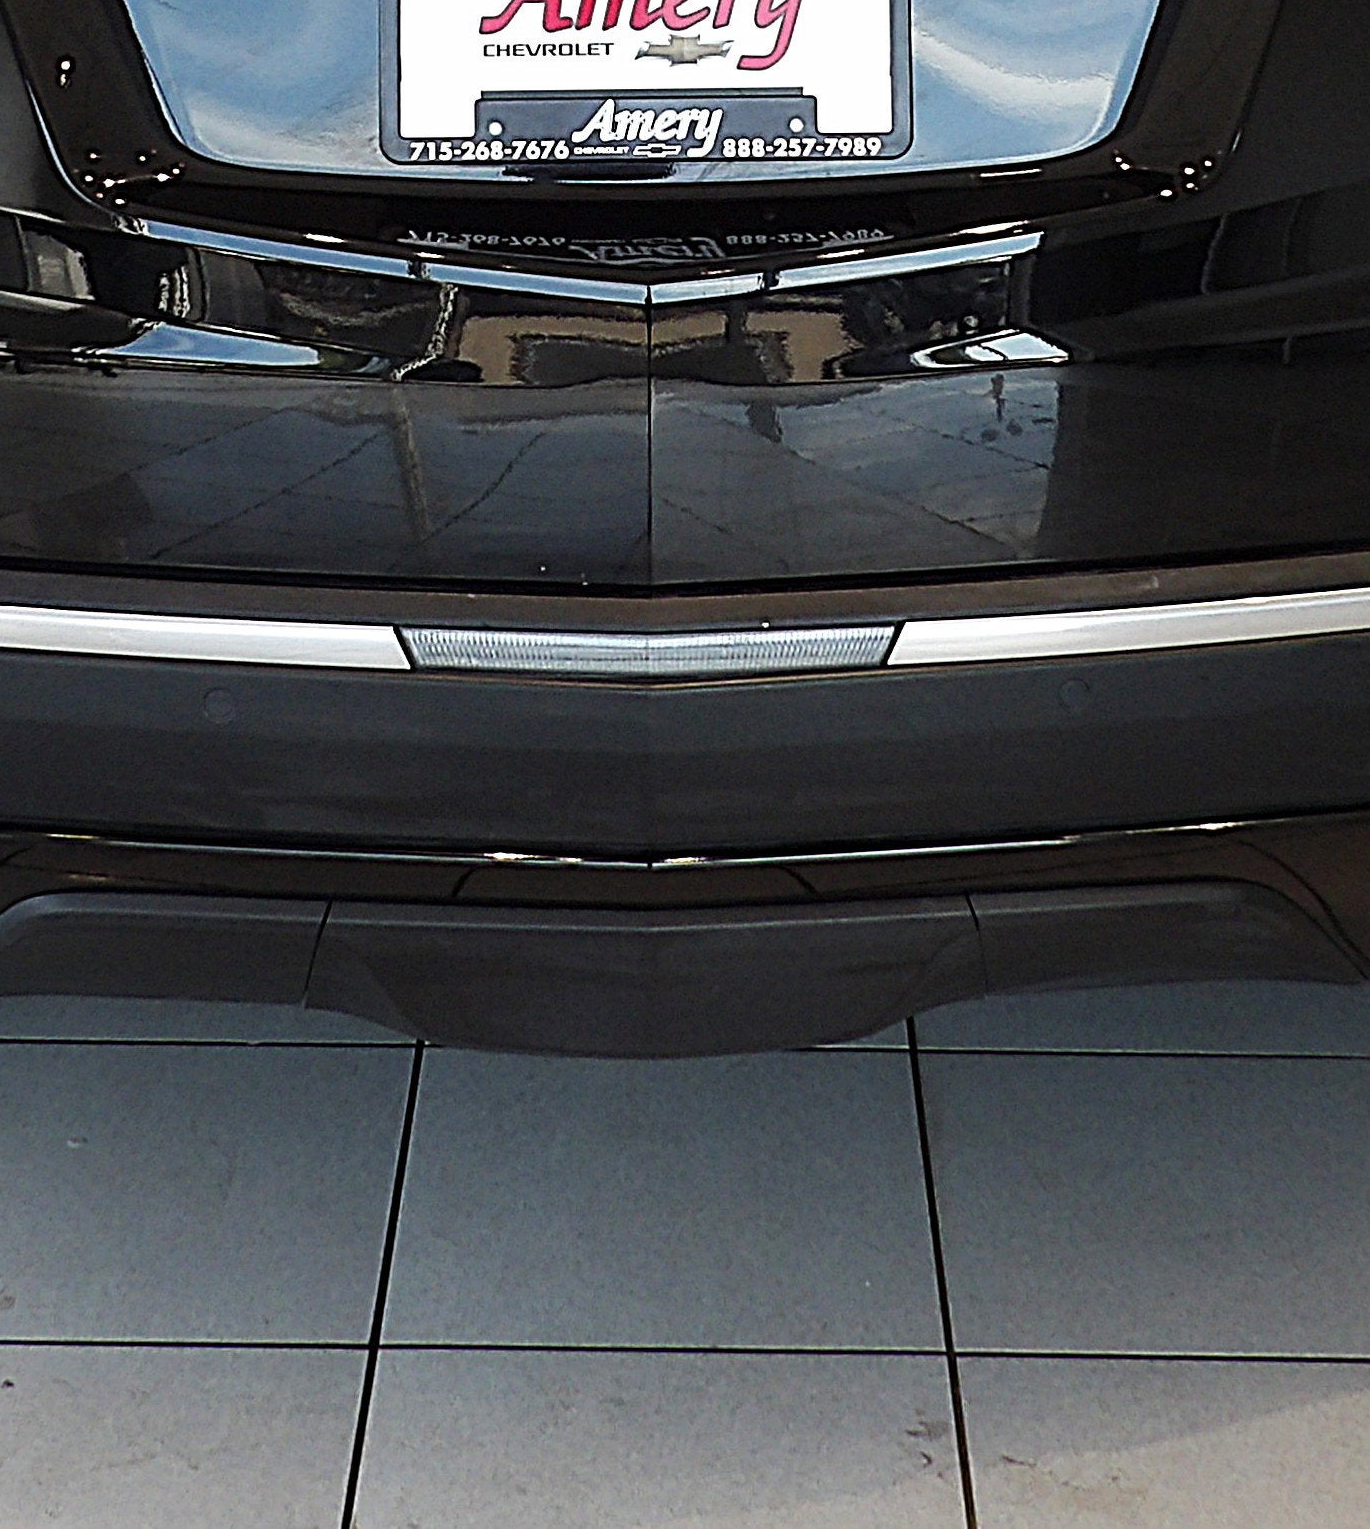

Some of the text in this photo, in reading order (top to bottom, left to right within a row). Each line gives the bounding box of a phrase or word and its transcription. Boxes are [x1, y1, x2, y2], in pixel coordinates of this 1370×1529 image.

[483, 42, 614, 57] CHEVROLET
[572, 99, 724, 157] Amery
[409, 140, 570, 161] 715-268-7676
[722, 137, 882, 158] 888-257-7989
